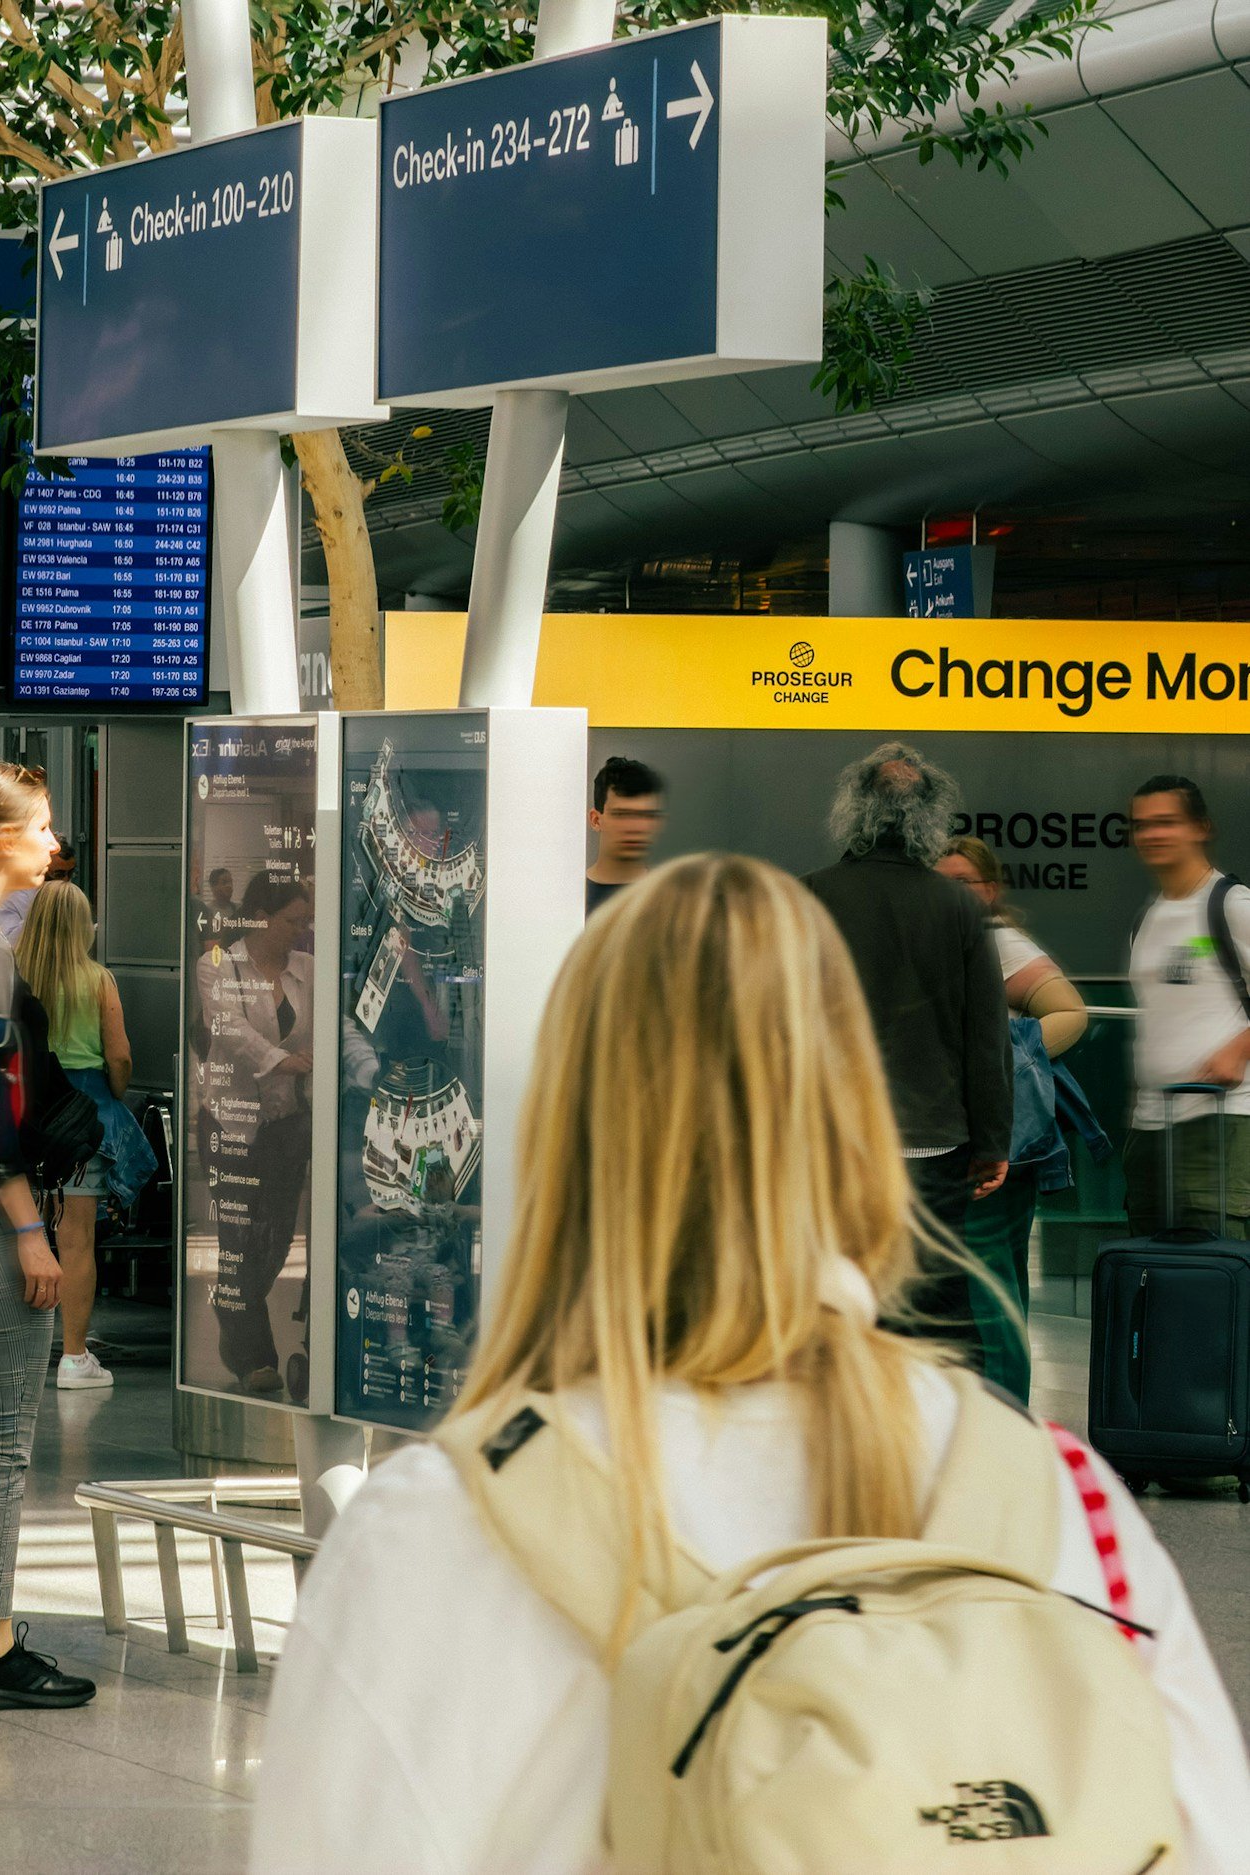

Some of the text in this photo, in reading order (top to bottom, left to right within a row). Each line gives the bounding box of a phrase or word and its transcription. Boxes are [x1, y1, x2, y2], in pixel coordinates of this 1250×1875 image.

[393, 103, 590, 189] Check-in 234–272
[130, 170, 294, 246] Check-in 100–210
[933, 558, 954, 571] Ausgang
[23, 571, 36, 579] EW
[56, 571, 70, 580] Bari
[114, 572, 132, 581] 16:55
[155, 573, 182, 582] 151-170
[20, 670, 35, 678] EW
[36, 670, 52, 678] 9970
[54, 670, 75, 679] Zadar
[111, 671, 130, 679] 17:20
[153, 672, 180, 680] 151-170
[752, 669, 852, 688] PROSEGUR
[891, 648, 1132, 717] Change
[20, 686, 31, 694] XQ
[34, 686, 49, 694] 1391
[53, 686, 90, 697] Gaziantep
[111, 687, 129, 695] 17:40
[773, 691, 829, 704] CHANGE
[351, 781, 367, 793] Gates
[951, 812, 1129, 849] PROSEG
[1001, 863, 1088, 890] ANGE
[351, 924, 372, 936] Gates B
[463, 965, 484, 977] Gates C
[220, 1172, 245, 1184] Conference
[366, 1291, 384, 1307] Abflug
[386, 1293, 404, 1308] Ebene
[366, 1307, 395, 1325] Departures
